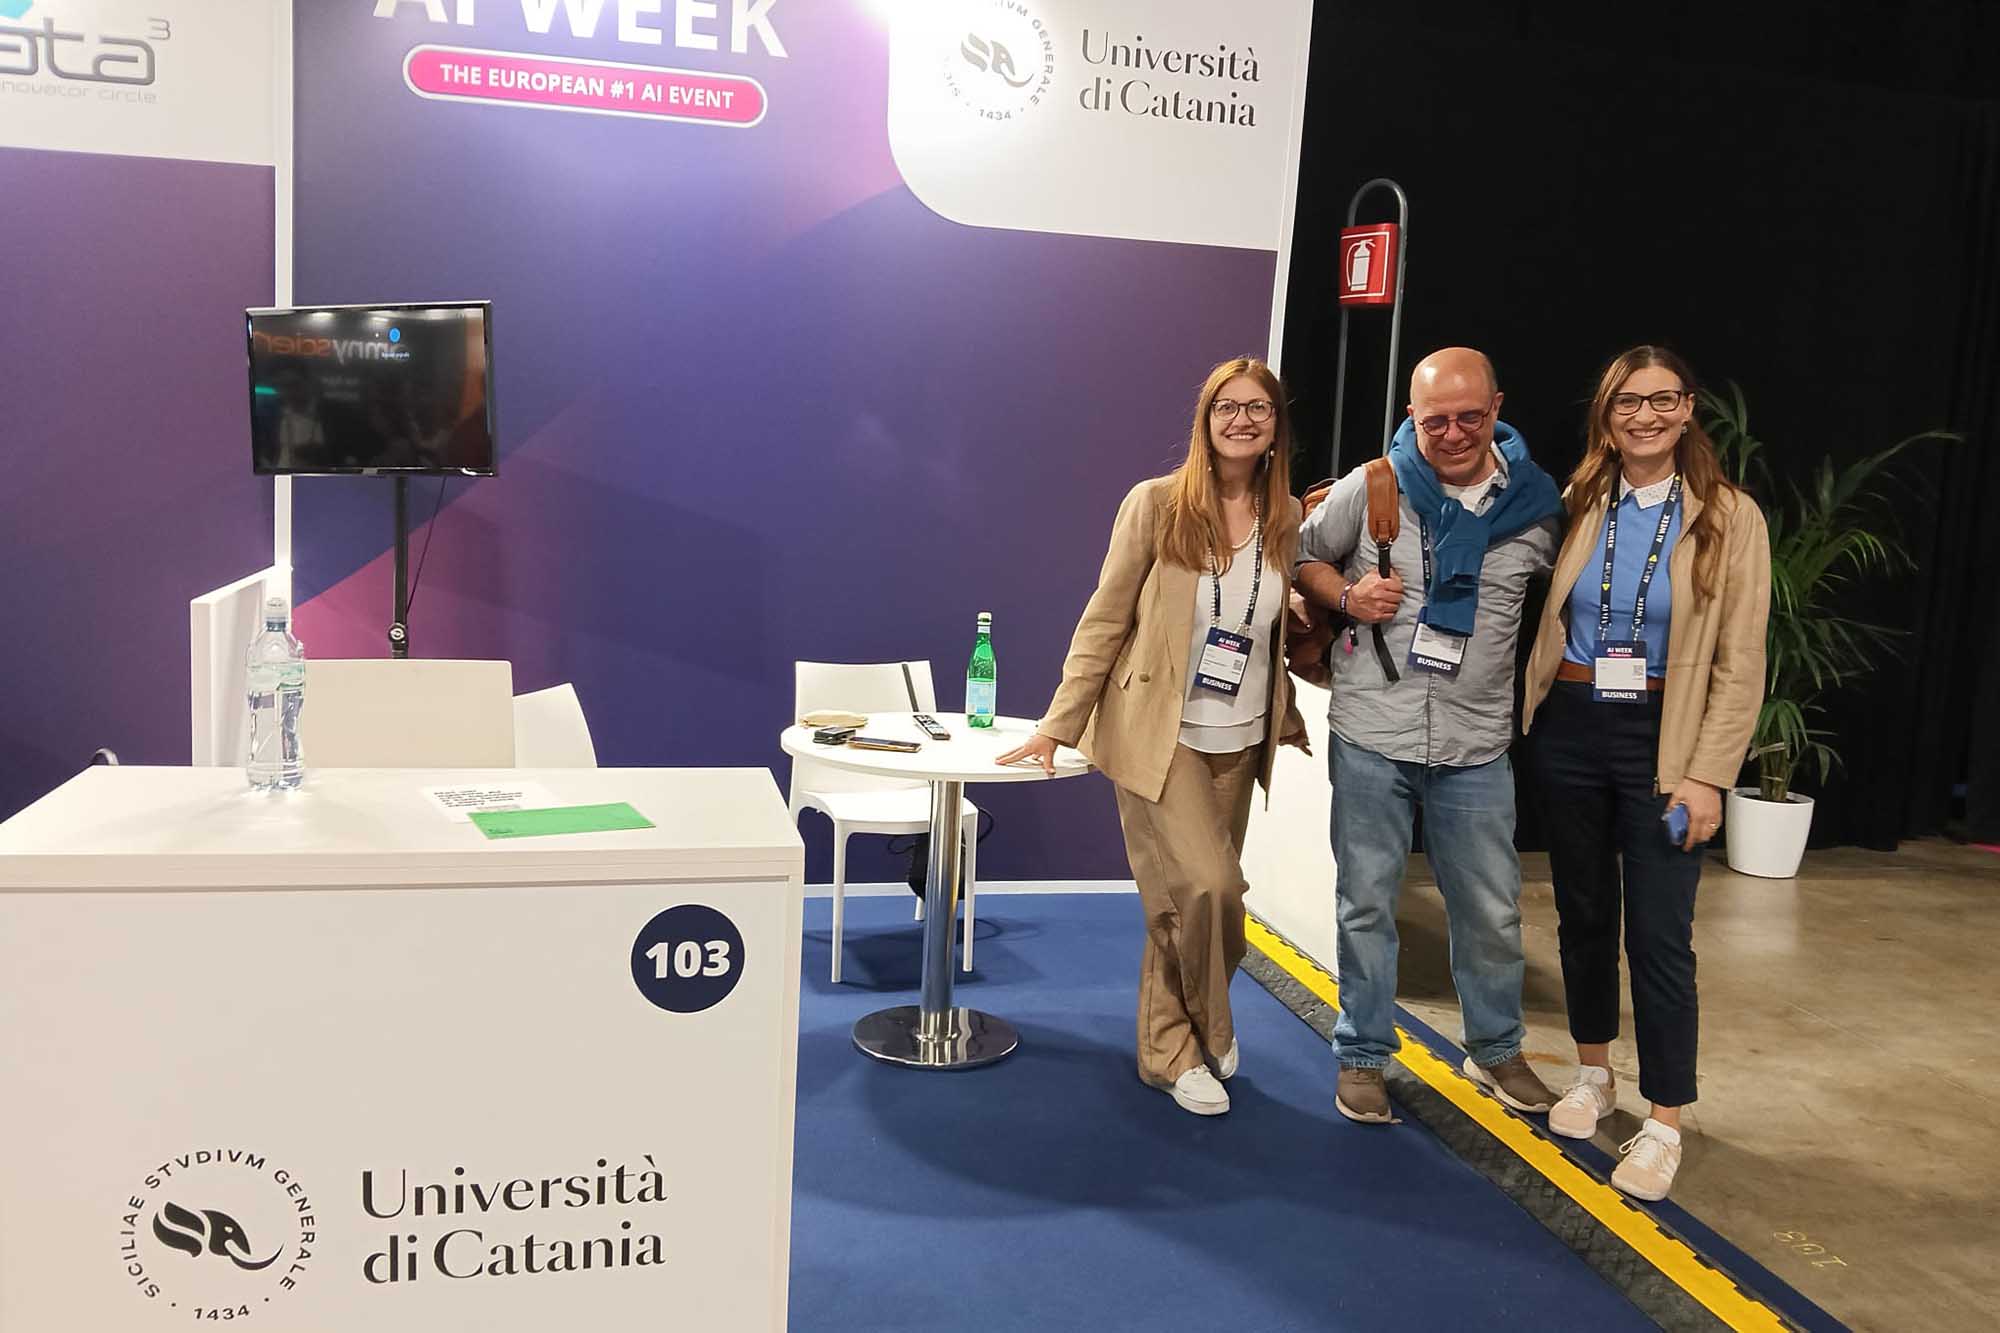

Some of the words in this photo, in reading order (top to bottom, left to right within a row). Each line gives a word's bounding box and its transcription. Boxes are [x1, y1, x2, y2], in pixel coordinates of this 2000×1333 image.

[1081, 29, 1260, 82] Università
[440, 63, 482, 85] THE
[488, 68, 605, 97] EUROPEAN
[610, 80, 634, 99] #1
[641, 83, 662, 102] AI
[669, 86, 734, 109] EVENT
[1079, 77, 1112, 111] di
[1120, 79, 1257, 127] Catania
[1201, 677, 1233, 691] BUSINESS
[1416, 657, 1452, 671] BUSINESS
[1601, 691, 1638, 699] BUSINESS
[645, 940, 730, 979] 103
[362, 1154, 668, 1219] Università
[120, 1195, 161, 1298] SICILIAE
[144, 1149, 267, 1189] STVDIVM
[273, 1169, 316, 1291] GENERALE
[363, 1234, 418, 1284] di
[433, 1220, 666, 1279] Catania
[193, 1304, 250, 1321] 1434
